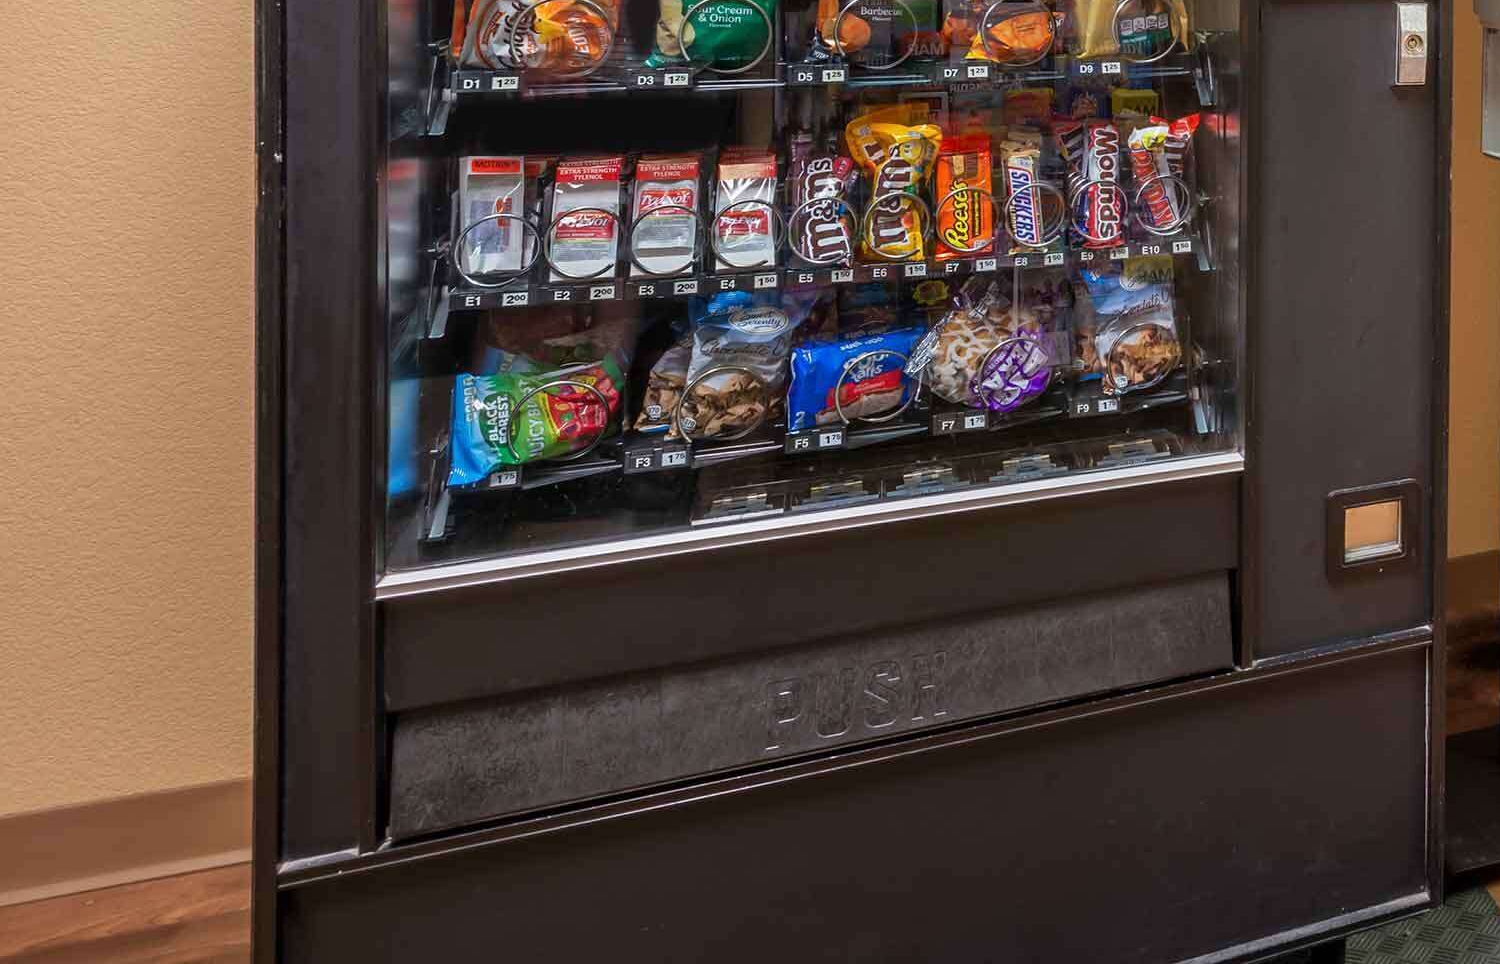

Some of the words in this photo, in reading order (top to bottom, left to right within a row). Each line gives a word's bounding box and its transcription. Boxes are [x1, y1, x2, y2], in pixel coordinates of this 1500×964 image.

[716, 4, 753, 15] Cream
[698, 13, 707, 22] &
[709, 13, 741, 23] Onion
[943, 68, 958, 77] D7
[1079, 64, 1093, 74] D9
[637, 76, 654, 86] D3
[797, 72, 813, 82] D5
[463, 79, 480, 89] D1
[559, 167, 581, 175] EXTRA
[582, 166, 617, 174] STRENGTH
[1095, 128, 1120, 238] Mounds
[1011, 170, 1036, 242] SNICKERS
[944, 179, 969, 249] Reese's
[1141, 245, 1160, 254] E10
[1080, 251, 1094, 261] E9
[1014, 257, 1028, 266] E8
[945, 263, 960, 272] E7
[798, 273, 813, 283] E5
[873, 268, 888, 278] E6
[720, 279, 736, 289] E4
[554, 290, 571, 300] E2
[639, 285, 655, 295] E3
[465, 296, 481, 306] E1
[1076, 403, 1090, 414] F9
[487, 399, 499, 441] BLACK
[497, 395, 510, 444] FOREST
[941, 420, 955, 431] F7
[528, 418, 545, 458] JUICY
[794, 438, 809, 449] F5
[635, 457, 651, 468] F3
[764, 649, 948, 752] PUSH
